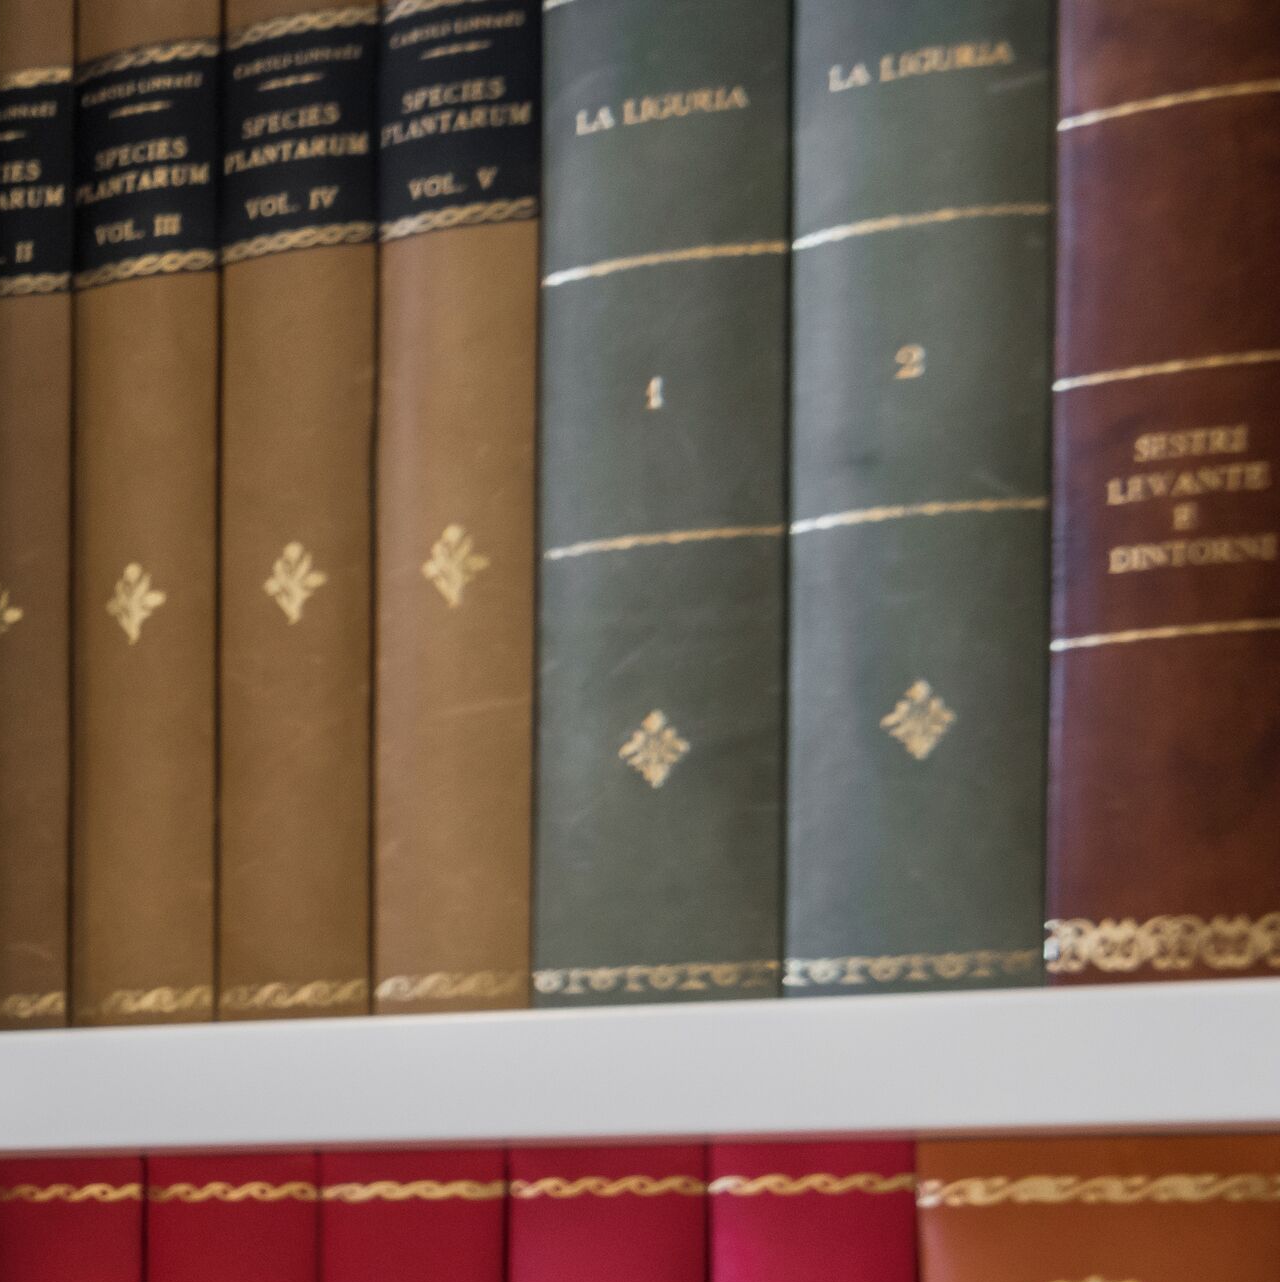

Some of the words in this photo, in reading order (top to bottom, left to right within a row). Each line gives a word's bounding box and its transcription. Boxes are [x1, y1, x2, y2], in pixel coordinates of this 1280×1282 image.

[828, 62, 870, 93] LA
[879, 40, 1015, 82] LIGURIA
[402, 76, 506, 114] SPECIES
[575, 106, 615, 135] LA
[622, 85, 749, 126] LIGURIA
[242, 102, 340, 139] SPECIES
[380, 102, 532, 148] PLANTARUM
[95, 136, 189, 171] SPECIES
[224, 132, 368, 176] PLANTARUM
[76, 162, 210, 203] PLANTARUM
[408, 171, 466, 200] VOL.
[476, 166, 498, 190] V
[245, 191, 300, 219] VOL.
[309, 185, 338, 211] IV
[153, 213, 182, 237] III
[894, 343, 925, 379] 2
[646, 375, 664, 410] 1
[1134, 424, 1248, 463] SESTRI
[1107, 460, 1271, 506] LEVANTE
